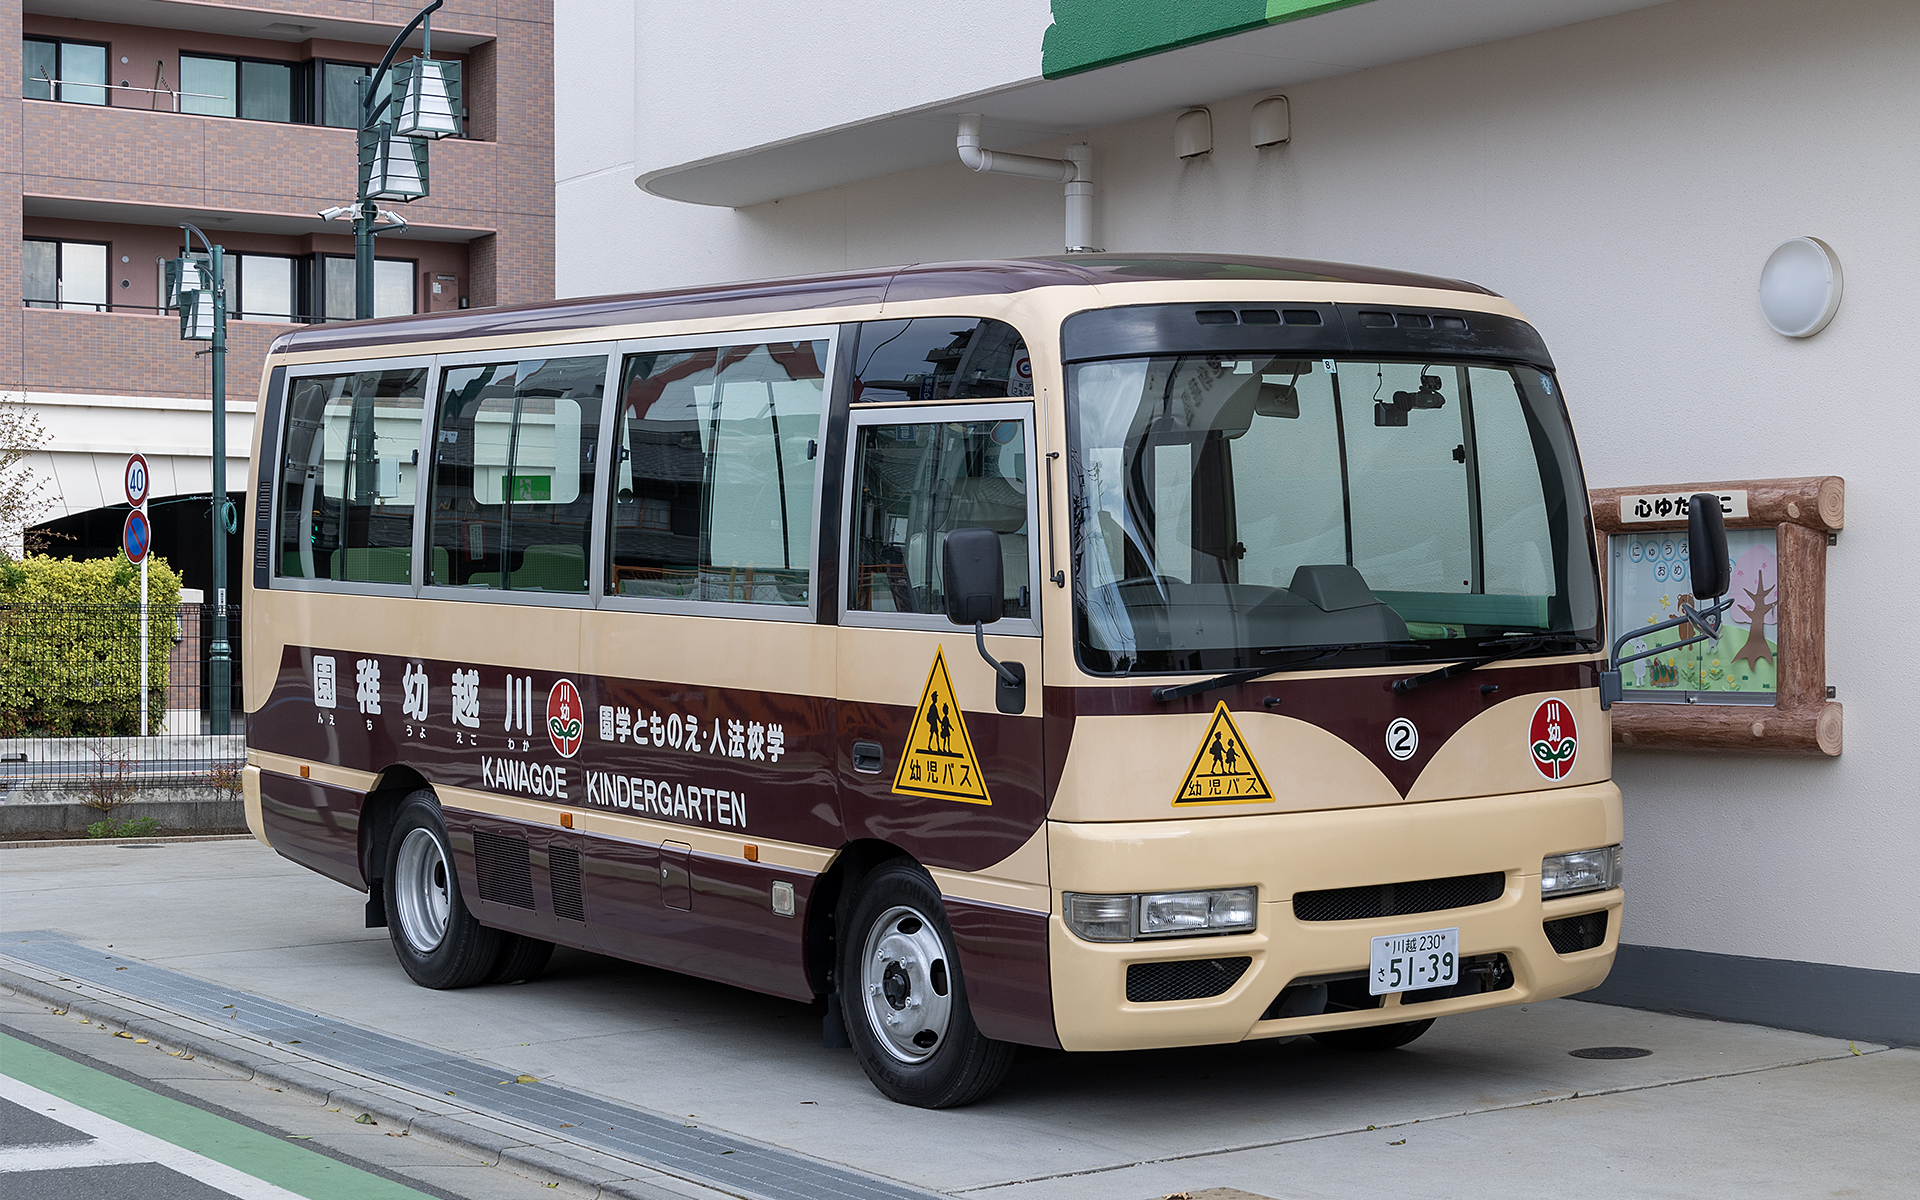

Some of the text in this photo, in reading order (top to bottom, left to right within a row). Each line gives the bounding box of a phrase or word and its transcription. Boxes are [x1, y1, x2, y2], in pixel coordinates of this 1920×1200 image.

[130, 468, 144, 492] 40
[1634, 496, 1733, 518] 心ゆたに
[1393, 725, 1411, 751] 2
[909, 758, 972, 788] 幼児バス
[481, 755, 746, 828] KAWAGOE KINDERGARTEN
[1188, 777, 1258, 796] 幼児バス
[1389, 951, 1454, 988] 51-39
